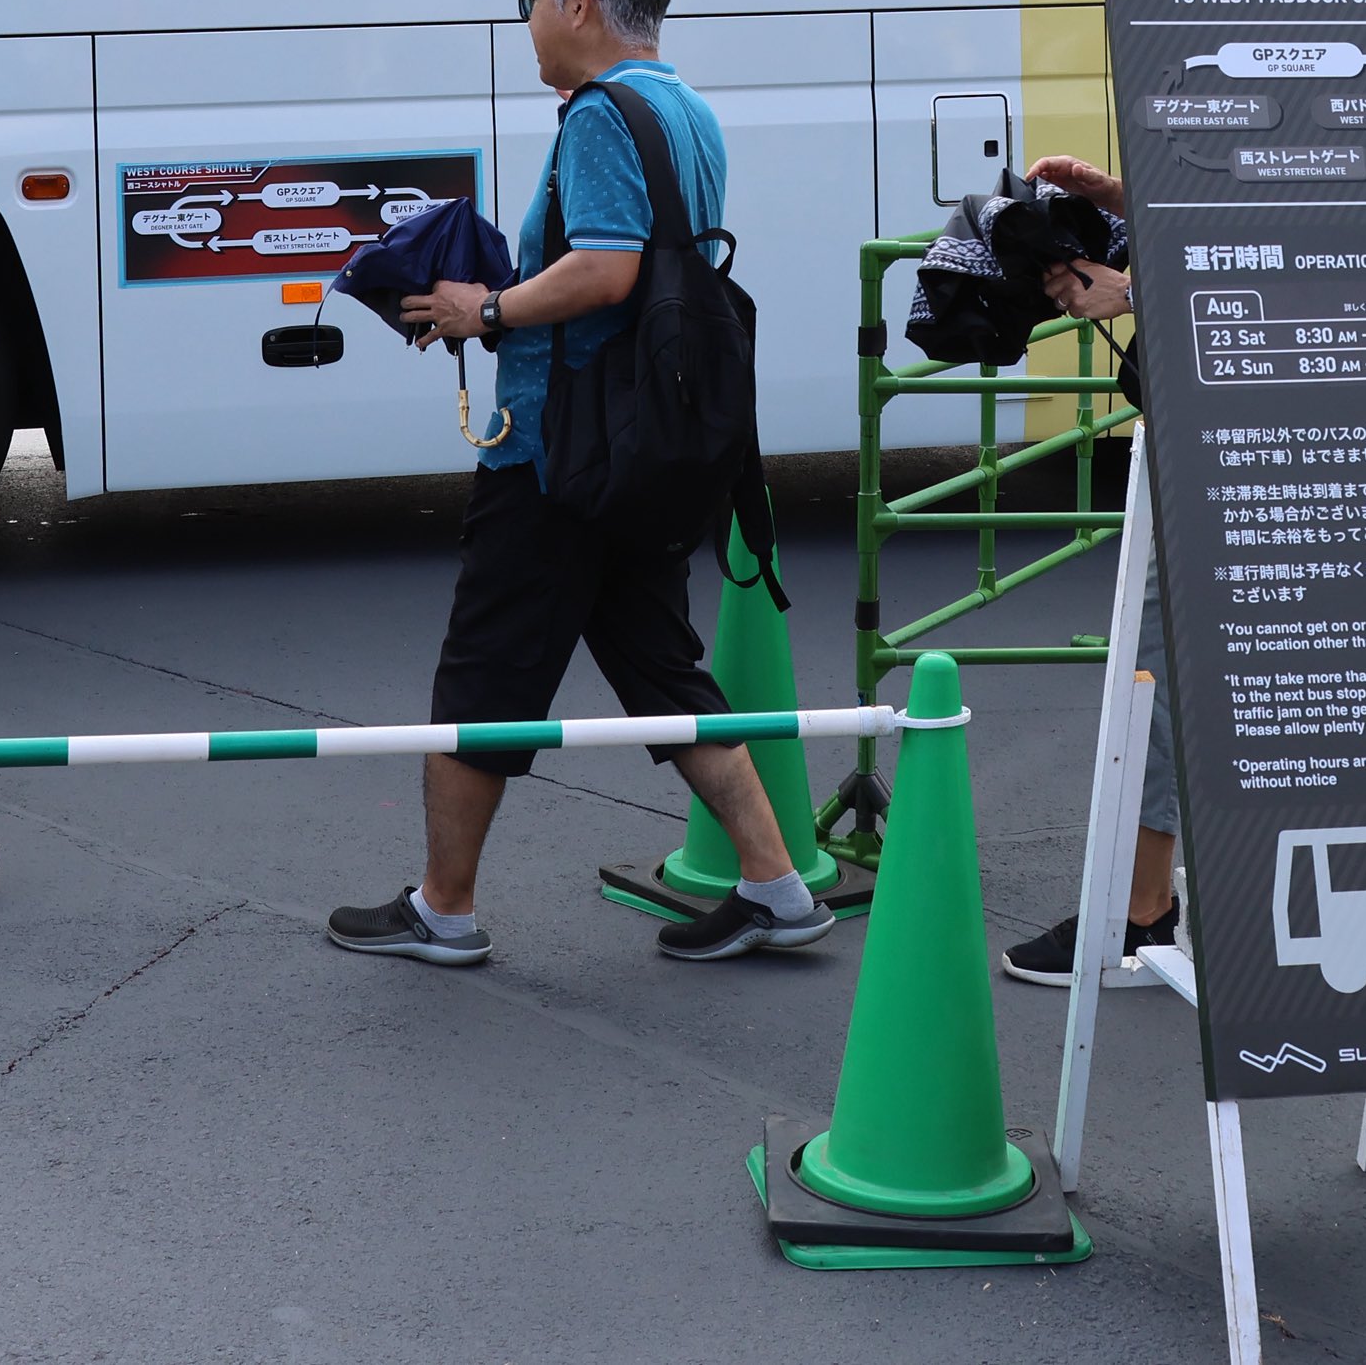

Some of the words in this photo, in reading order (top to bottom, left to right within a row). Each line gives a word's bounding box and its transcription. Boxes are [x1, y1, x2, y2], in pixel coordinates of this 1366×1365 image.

[1253, 48, 1326, 60] GPスクエア
[1268, 64, 1279, 72] GP
[1282, 64, 1315, 72] SQUARE
[1153, 100, 1259, 113] デグナー東ゲート
[1167, 117, 1201, 125] DEGNER
[1203, 117, 1225, 126] EAST
[1226, 116, 1249, 125] GATE
[1340, 116, 1364, 124] WEST
[1240, 150, 1359, 165] 西ストレートゲート
[126, 167, 156, 177] WEST
[159, 165, 202, 176] COURSE
[205, 164, 252, 175] SHUTTLE
[1257, 167, 1281, 177] WEST
[1284, 167, 1322, 176] STRETCH
[1324, 167, 1346, 175] GATE
[127, 181, 181, 190] 西コースシャトル
[277, 187, 324, 196] GPスクエア
[143, 213, 210, 223] デグナー東ゲート
[264, 232, 339, 243] 西ストレートゲート
[1184, 245, 1284, 270] 運行時間
[1207, 298, 1248, 318] Aug.
[1211, 330, 1231, 346] 23
[1238, 330, 1266, 345] Sat
[1296, 327, 1333, 344] 8:30
[1338, 331, 1357, 342] AM
[1214, 360, 1235, 375] 24
[1242, 359, 1273, 375] Sun
[1299, 357, 1336, 373] 8:30
[1342, 360, 1360, 372] AM
[1233, 586, 1306, 603] ございます
[1257, 622, 1303, 634] cannot
[1307, 621, 1328, 636] get
[1331, 622, 1348, 632] on
[1352, 622, 1366, 631] or
[1228, 642, 1251, 654] any
[1256, 638, 1309, 651] location
[1314, 637, 1348, 649] other
[1244, 673, 1271, 688] may
[1275, 673, 1304, 685] take
[1308, 673, 1342, 683] more
[1232, 692, 1246, 703] to
[1249, 690, 1271, 702] the
[1275, 689, 1304, 701] next
[1308, 688, 1333, 700] bus
[1337, 688, 1366, 701] stop
[1234, 707, 1273, 719] traffic
[1277, 706, 1301, 721] jam
[1306, 707, 1322, 717] on
[1326, 704, 1348, 716] the
[1236, 724, 1280, 736] Please
[1285, 722, 1319, 734] allow
[1324, 721, 1365, 736] plenty
[1310, 757, 1349, 769] hours
[1240, 775, 1291, 788] without
[1295, 773, 1337, 786] notice
